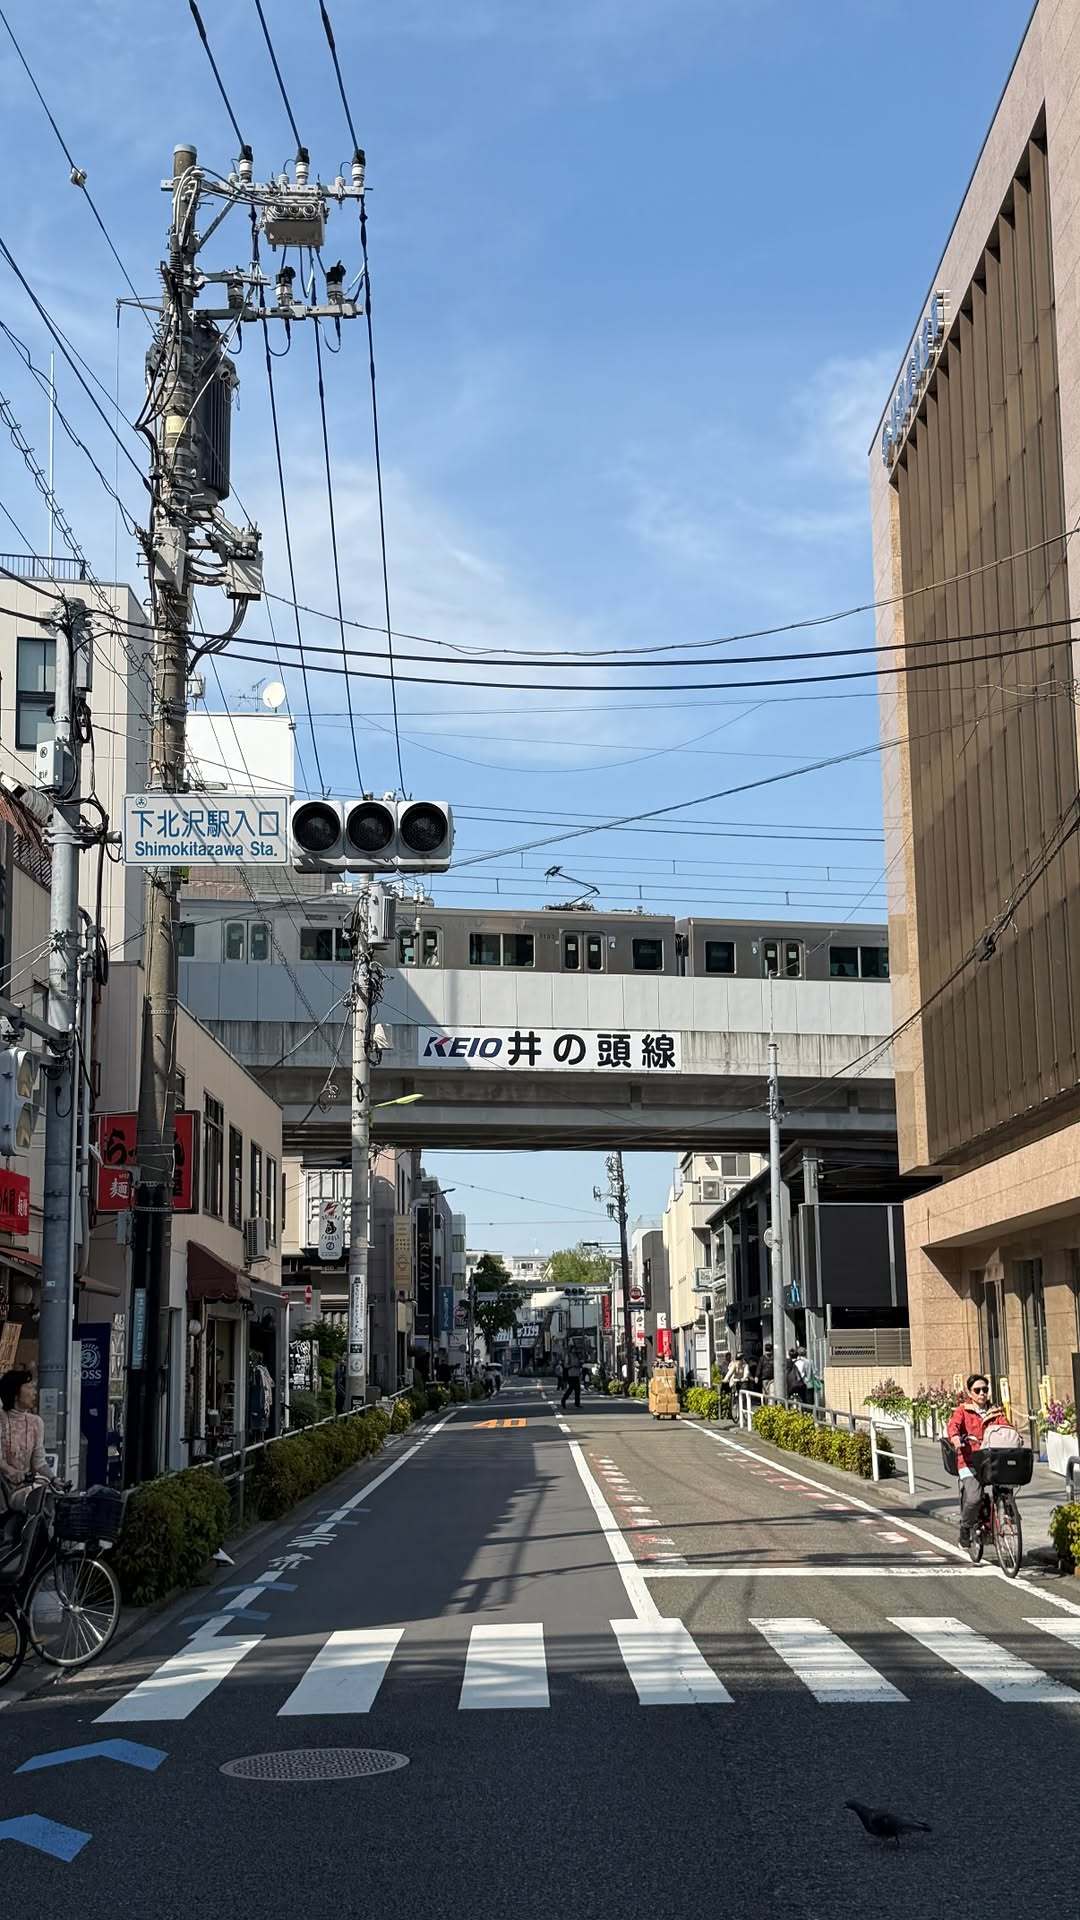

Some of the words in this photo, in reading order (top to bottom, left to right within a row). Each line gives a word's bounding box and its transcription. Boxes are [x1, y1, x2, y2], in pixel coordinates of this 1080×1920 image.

[131, 809, 279, 838] 下北沢駅入口
[135, 840, 244, 857] Shimokitazawa
[250, 841, 278, 857] Sta.
[423, 1036, 503, 1058] KEIO
[507, 1030, 676, 1068] 井の頭線
[81, 1369, 102, 1380] OSS
